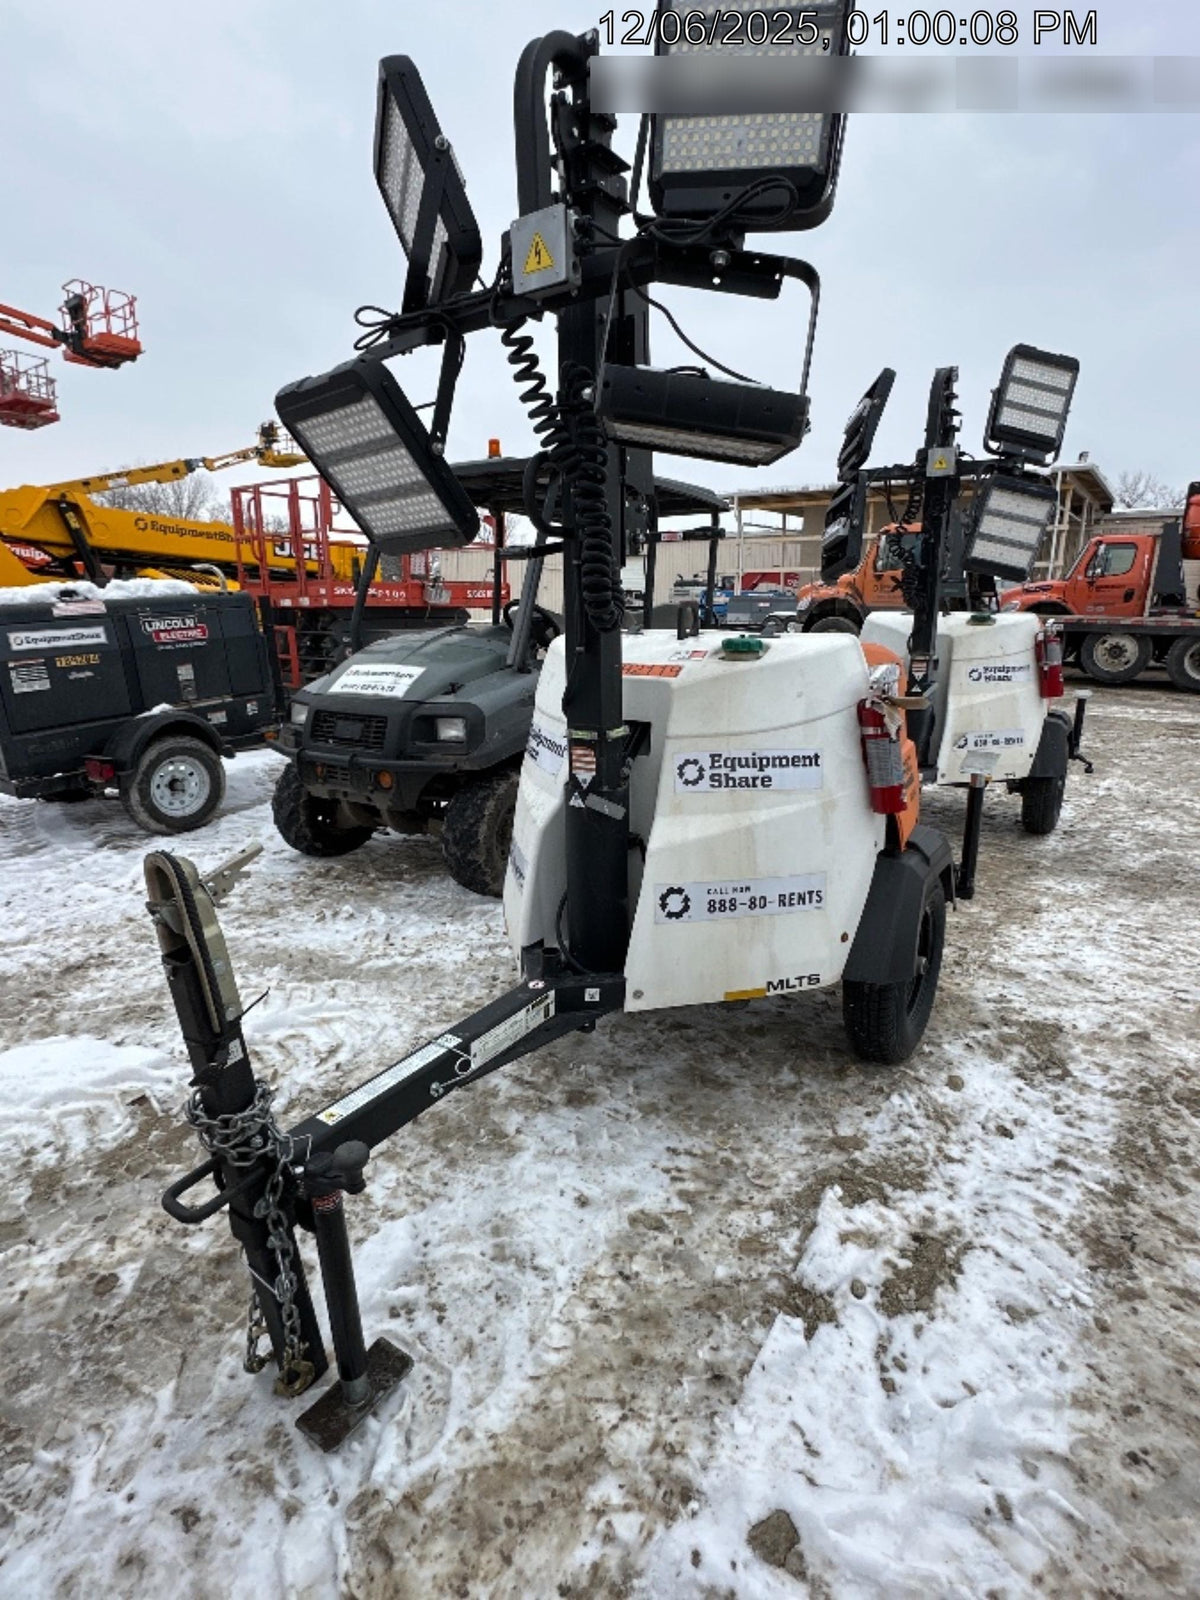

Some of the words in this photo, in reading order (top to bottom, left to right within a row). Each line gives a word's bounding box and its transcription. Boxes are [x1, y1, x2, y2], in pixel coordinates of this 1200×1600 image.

[144, 618, 195, 631] LINCOLN
[709, 752, 821, 772] Equipment
[709, 772, 773, 788] Share
[707, 890, 823, 914] 888-80-RENTS
